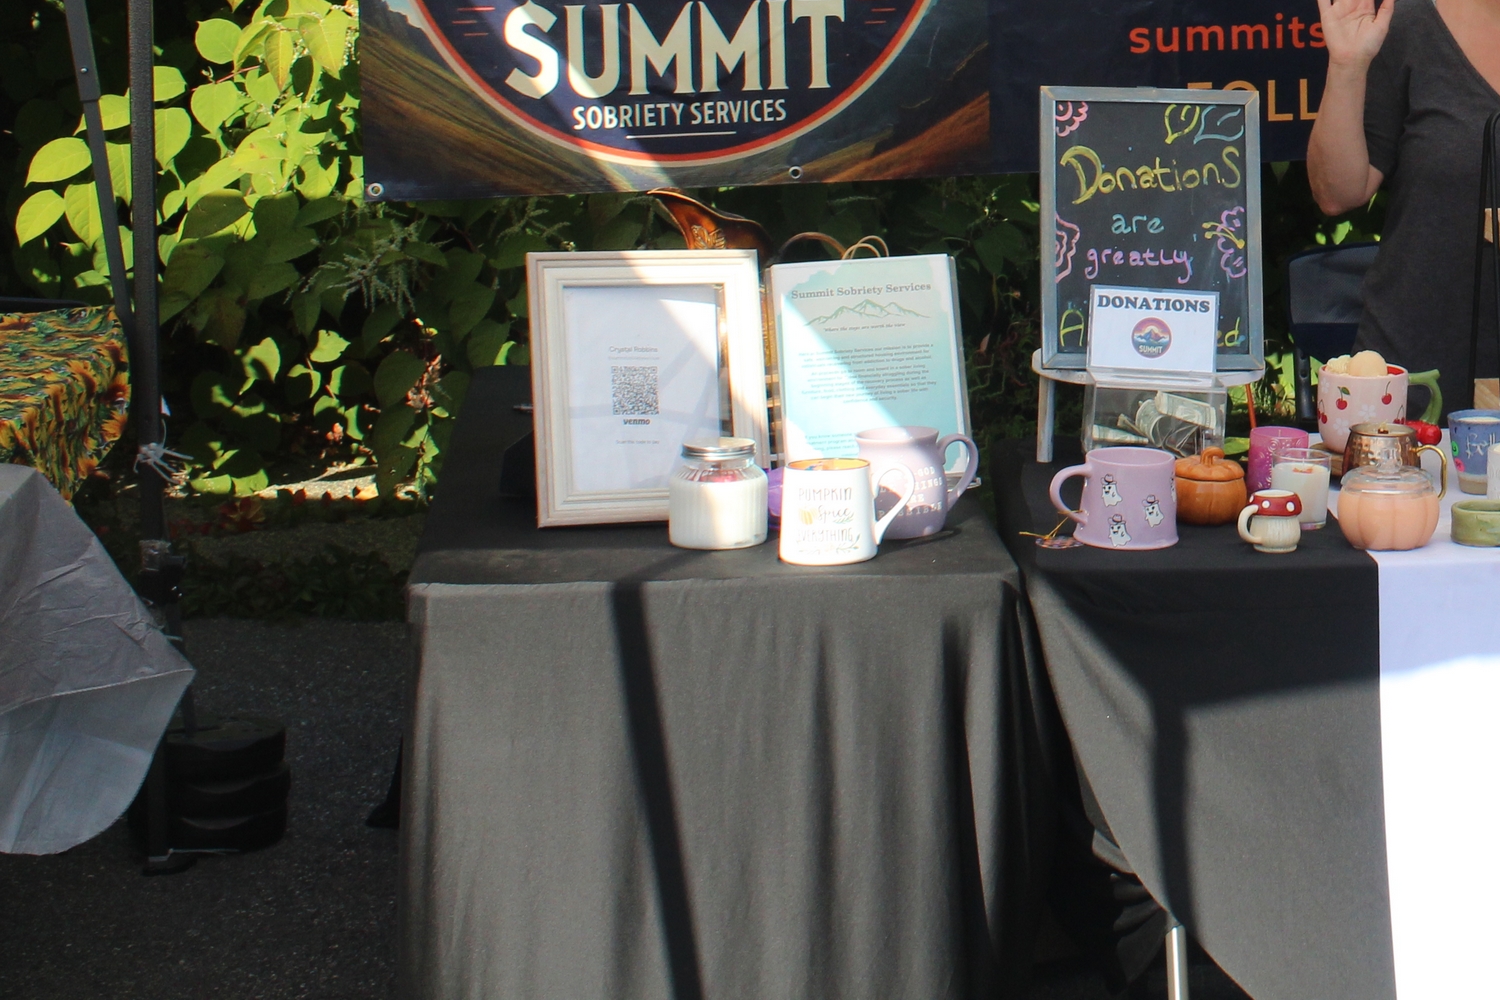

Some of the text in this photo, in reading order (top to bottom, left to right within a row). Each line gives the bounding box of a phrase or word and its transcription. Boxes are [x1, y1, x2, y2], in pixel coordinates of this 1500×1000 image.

[573, 99, 787, 131] SOBRIETY SERVICES
[1111, 213, 1165, 235] are
[1084, 247, 1193, 284] greatly
[791, 282, 932, 300] Summit Sobriety Services
[1097, 295, 1210, 313] DONATIONS
[609, 345, 658, 353] Crystal Robbins
[1138, 344, 1163, 354] SUMMIT
[798, 487, 852, 502] PUMPKIN
